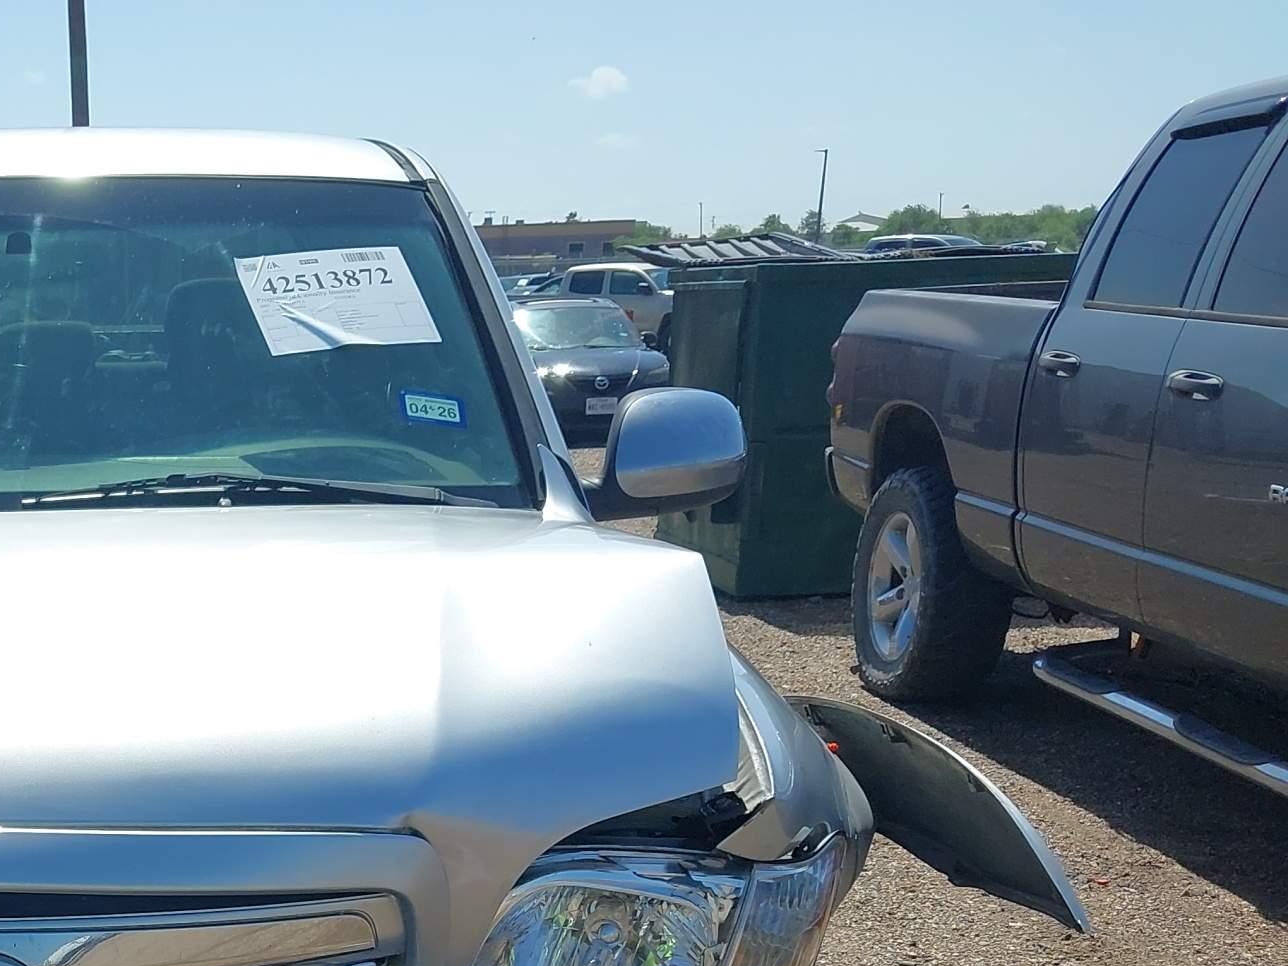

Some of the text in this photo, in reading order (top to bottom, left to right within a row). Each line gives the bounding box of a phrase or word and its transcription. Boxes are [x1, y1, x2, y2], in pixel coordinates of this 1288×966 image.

[262, 267, 393, 295] 42513872
[409, 402, 457, 419] 04 26
